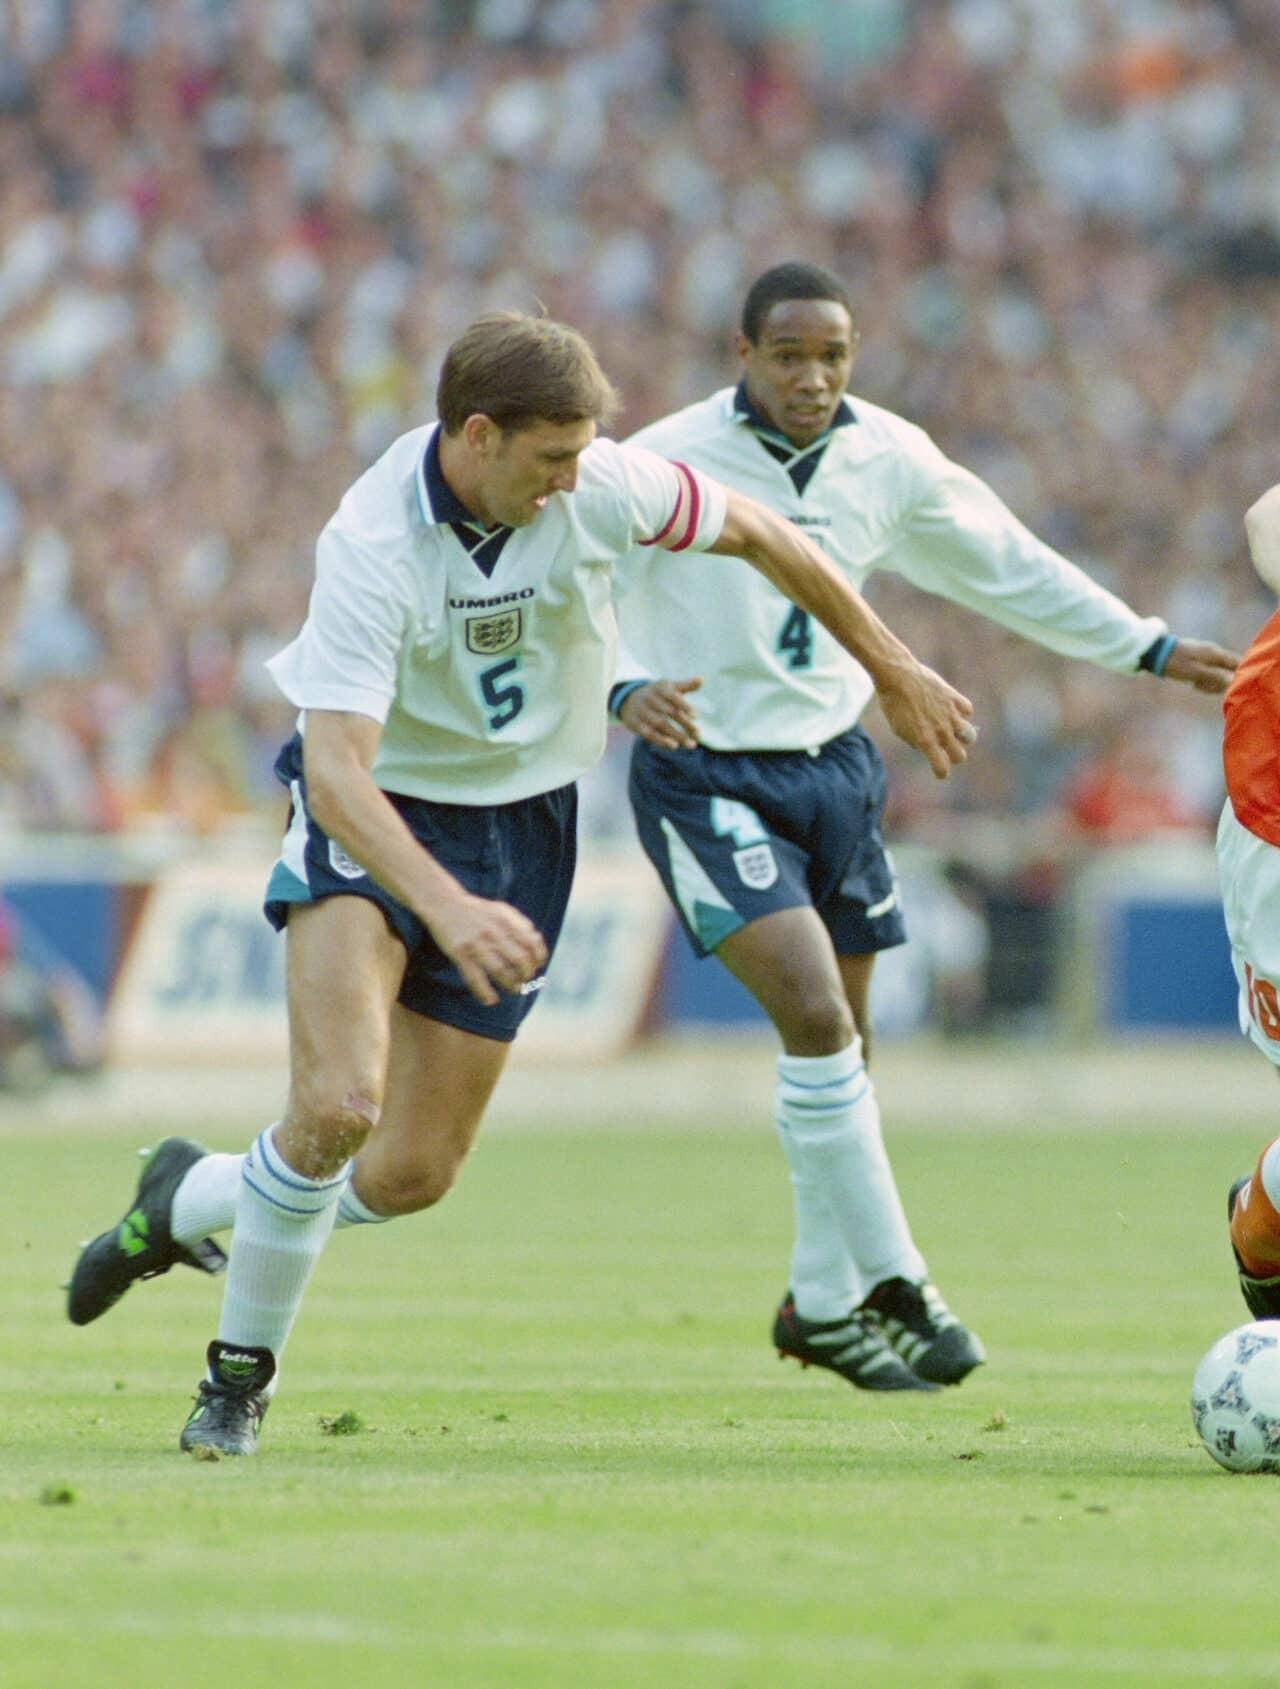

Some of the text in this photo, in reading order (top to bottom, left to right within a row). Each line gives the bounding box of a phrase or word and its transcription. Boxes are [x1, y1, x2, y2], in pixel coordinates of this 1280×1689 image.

[449, 587, 535, 609] UMBRO
[777, 604, 812, 668] 4
[478, 656, 525, 731] 5
